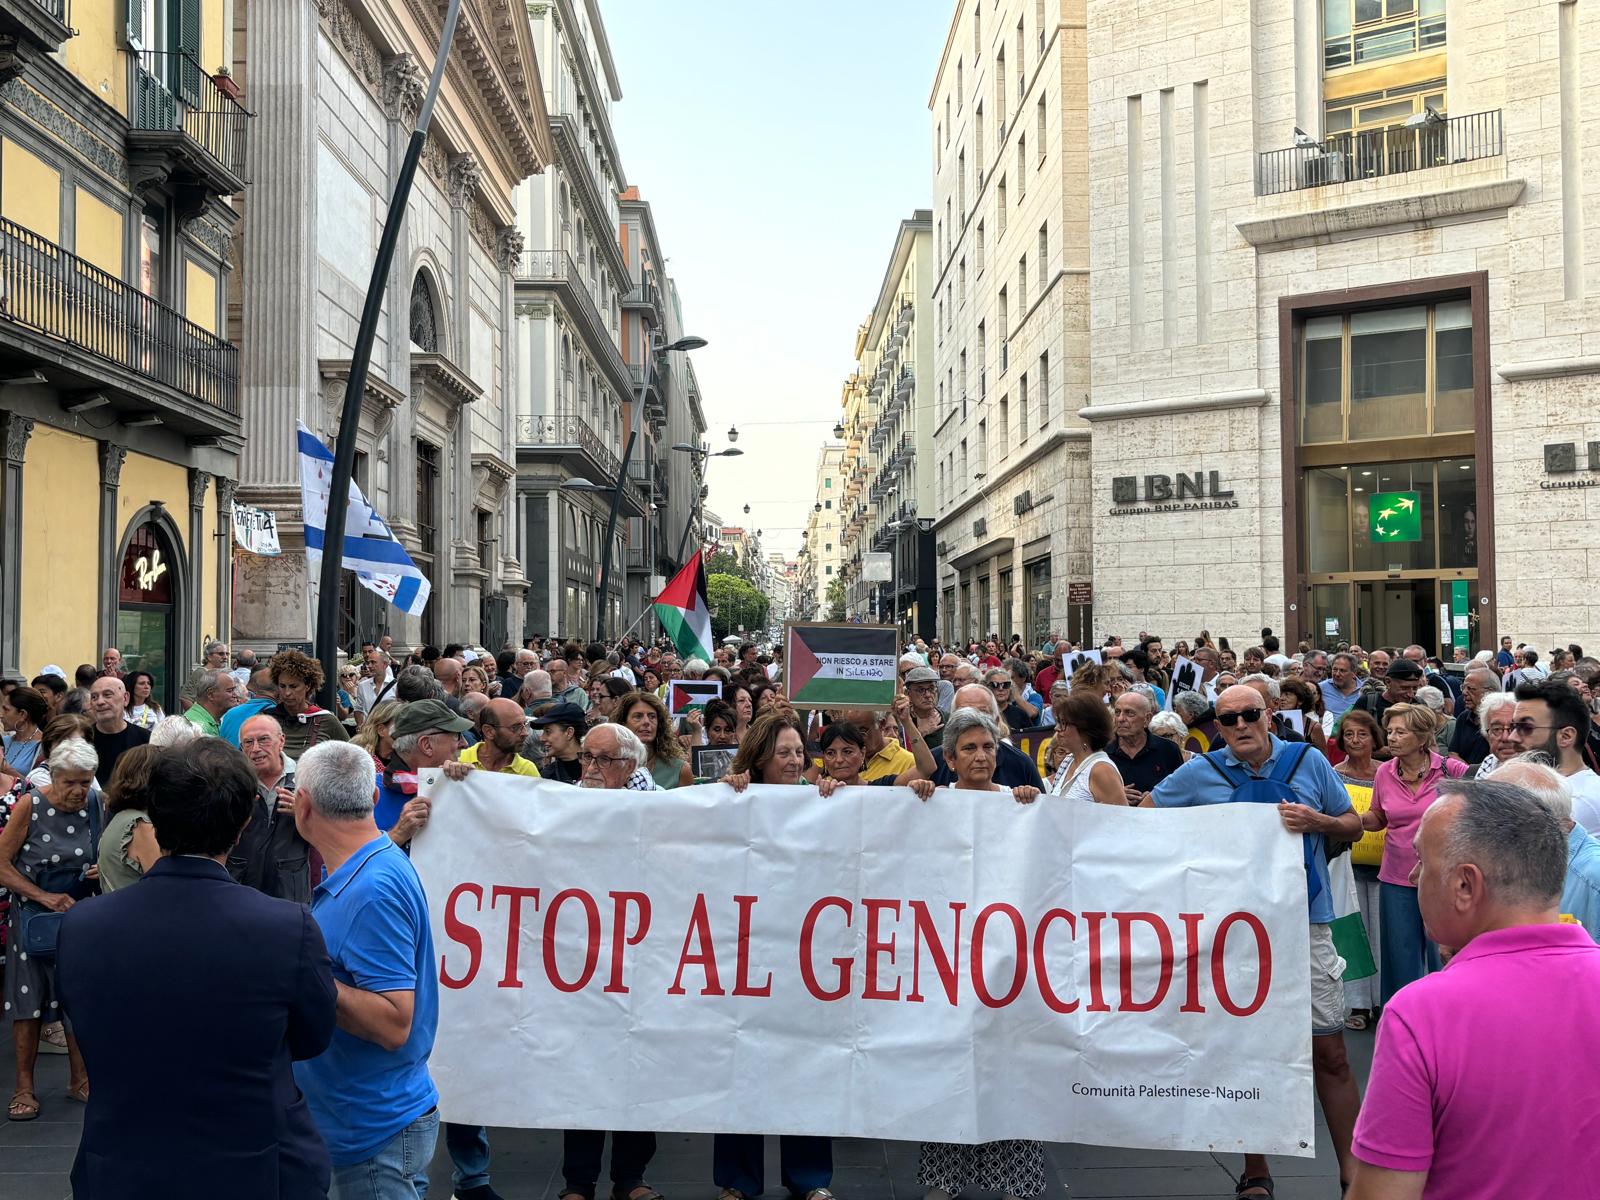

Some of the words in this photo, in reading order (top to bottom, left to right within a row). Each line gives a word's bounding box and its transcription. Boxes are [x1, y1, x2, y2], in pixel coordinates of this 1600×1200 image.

[1143, 470, 1234, 501] BNL
[1540, 480, 1596, 490] Gruppo
[1109, 507, 1151, 516] Gruppo
[1155, 503, 1181, 512] BNP
[1184, 500, 1239, 510] PARIBAS
[816, 657, 832, 665] NON
[833, 657, 861, 666] RIESCO
[862, 658, 868, 666] A
[869, 658, 894, 667] STARE
[836, 667, 844, 675] IN
[439, 882, 652, 993] STOP
[667, 893, 772, 998] AL
[799, 895, 1272, 1017] GENOCIDIO
[1071, 1082, 1136, 1098] Comunità
[1138, 1084, 1261, 1102] Palestinese-Napoli
